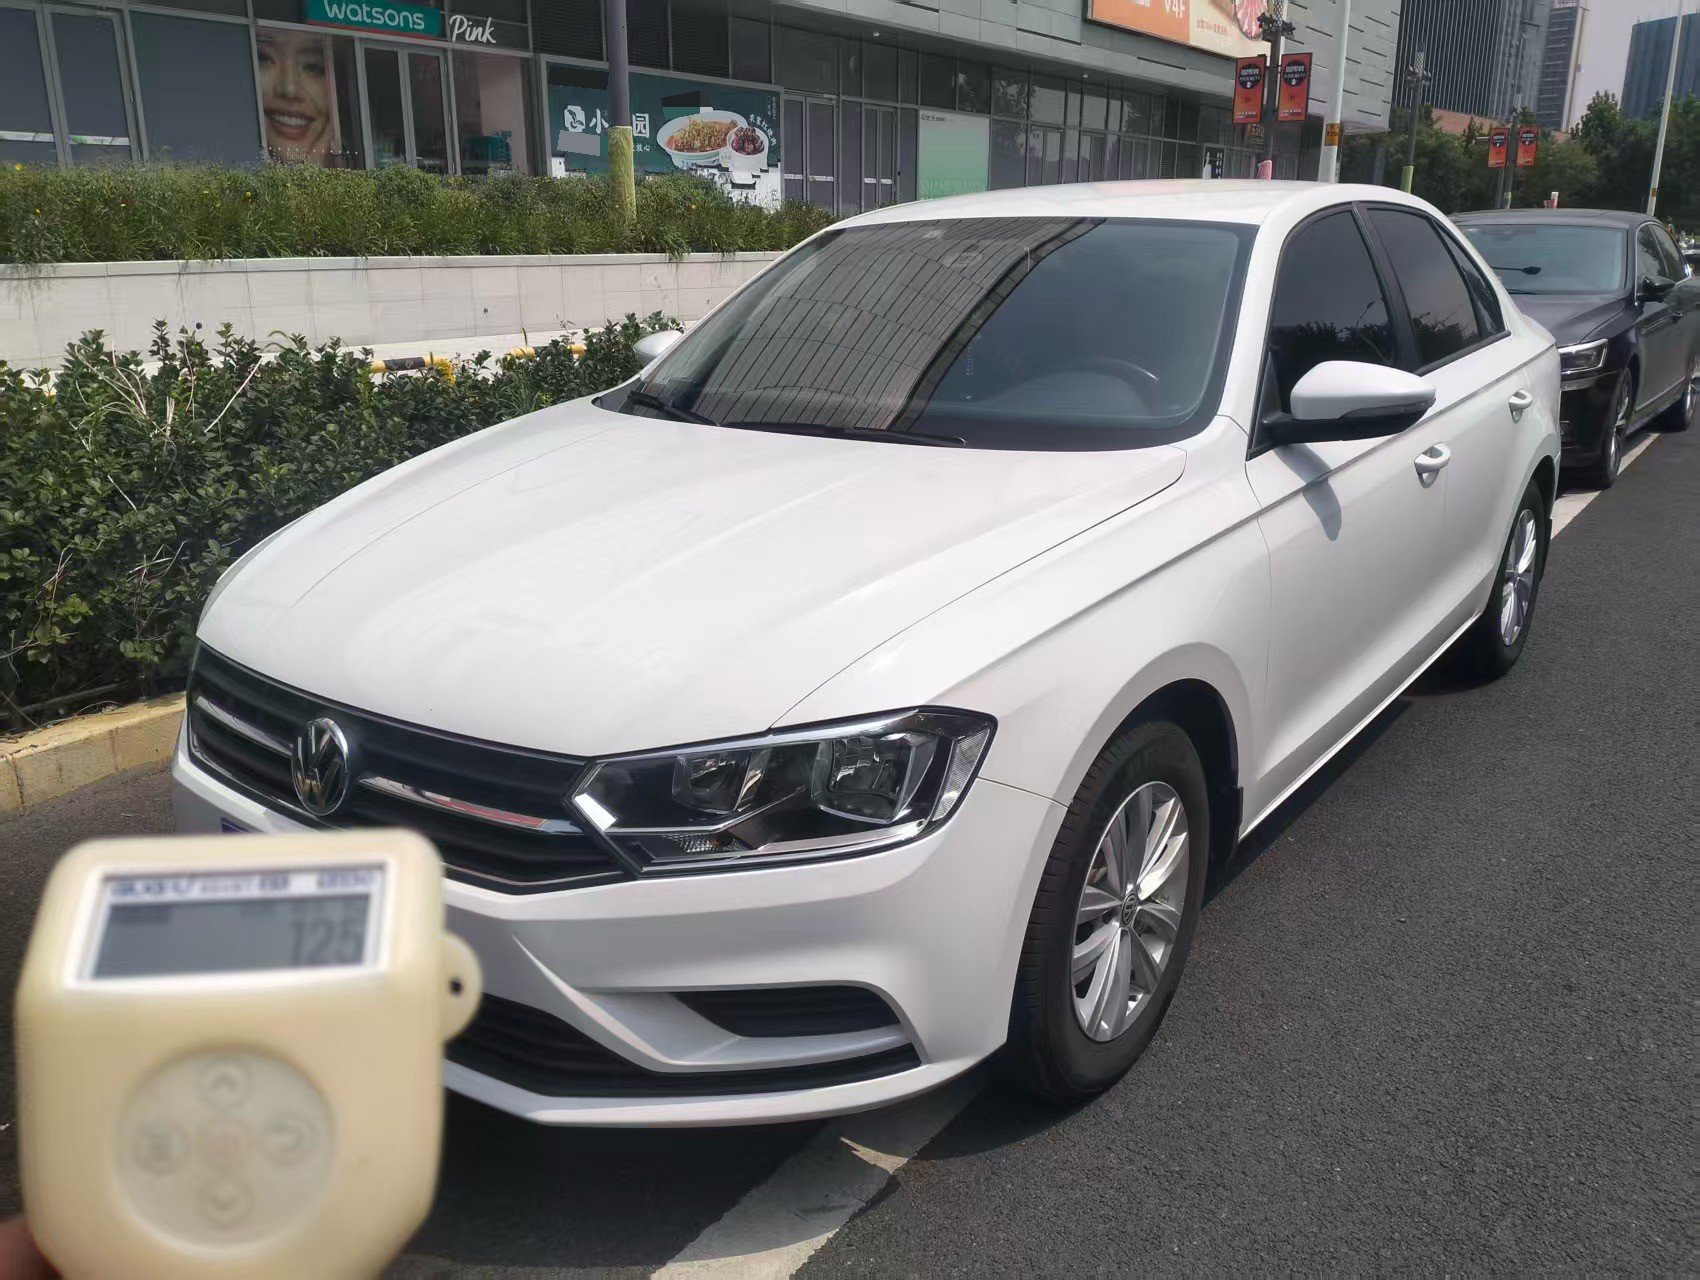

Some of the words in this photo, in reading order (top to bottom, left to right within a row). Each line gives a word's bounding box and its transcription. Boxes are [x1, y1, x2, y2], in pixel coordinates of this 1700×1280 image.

[324, 0, 425, 30] watsons
[449, 15, 497, 44] Pink
[589, 108, 650, 138] 小园
